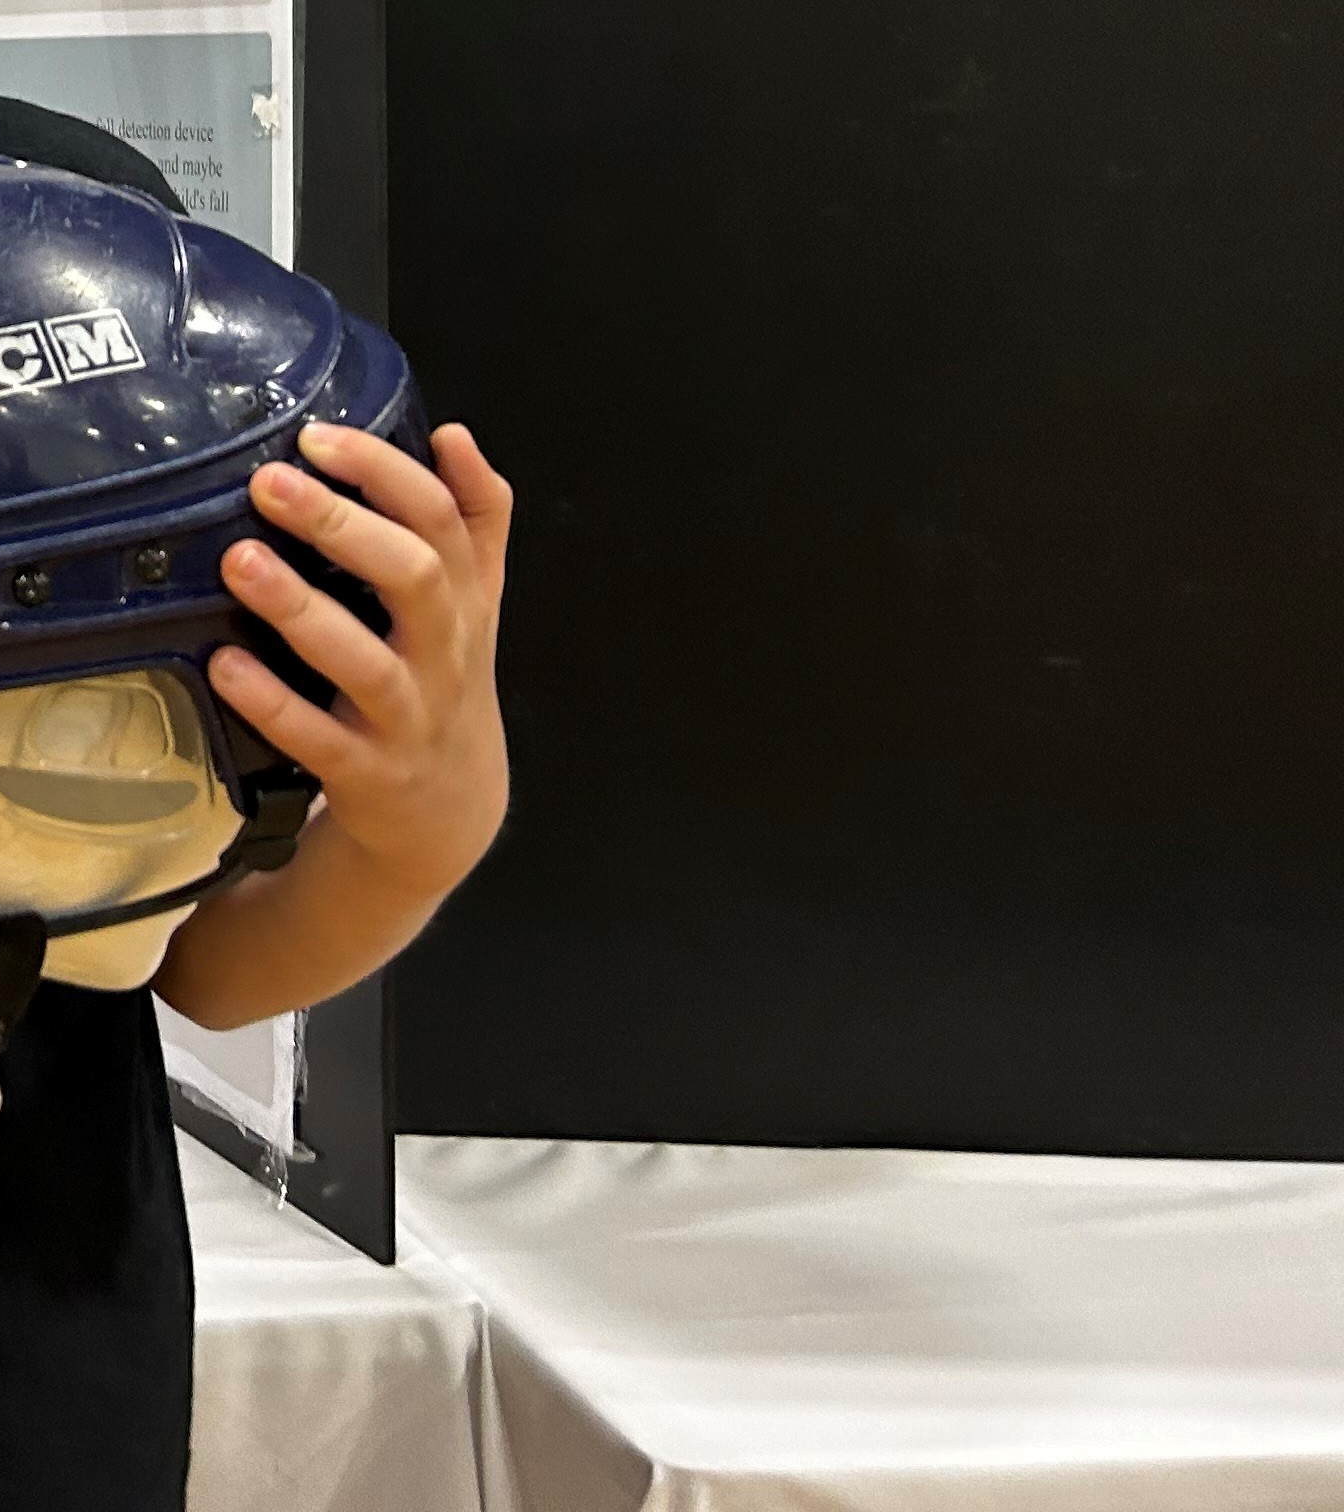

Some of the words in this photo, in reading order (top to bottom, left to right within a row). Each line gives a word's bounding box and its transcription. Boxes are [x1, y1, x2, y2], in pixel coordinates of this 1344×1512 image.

[118, 117, 171, 141] detection
[174, 120, 214, 143] device
[183, 157, 223, 182] maybe
[209, 189, 230, 213] fall
